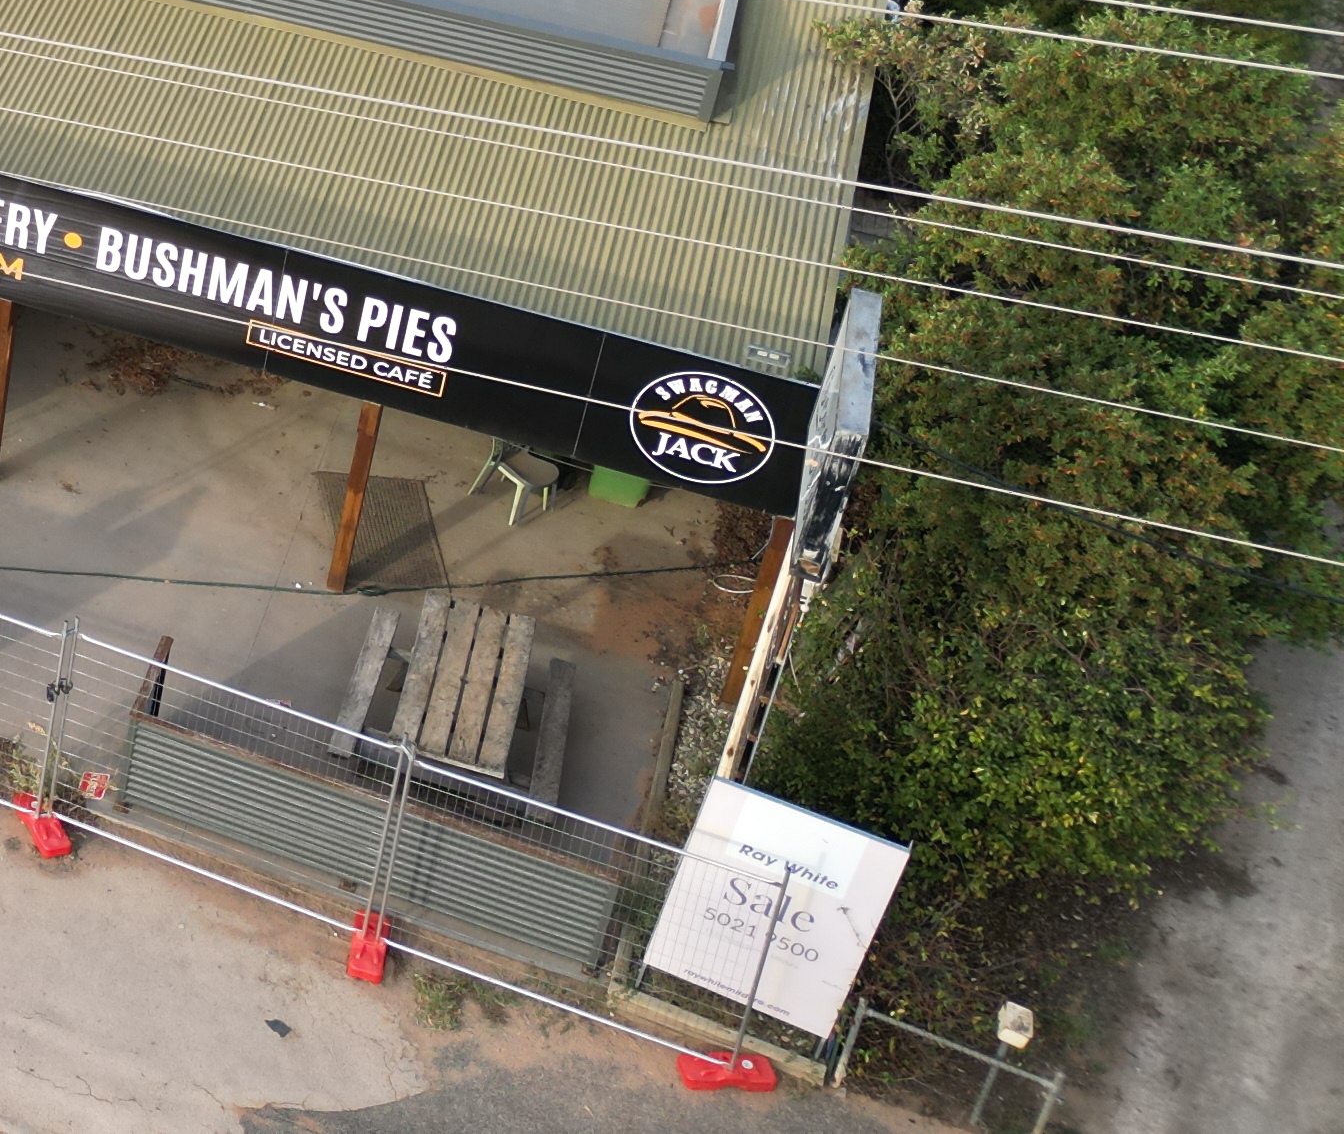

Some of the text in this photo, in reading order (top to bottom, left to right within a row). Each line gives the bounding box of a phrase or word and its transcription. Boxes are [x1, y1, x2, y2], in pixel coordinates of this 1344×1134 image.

[95, 226, 348, 335] BUSHMAN'S
[356, 295, 457, 364] PIES
[259, 328, 433, 390] LICENSED CAFÉ
[655, 377, 764, 423] SWAGMAN
[651, 431, 741, 473] JACK
[739, 844, 839, 890] Ray White
[703, 907, 757, 939] 5021
[723, 877, 815, 933] Sale
[683, 968, 791, 1017] raywhitemildra.com
